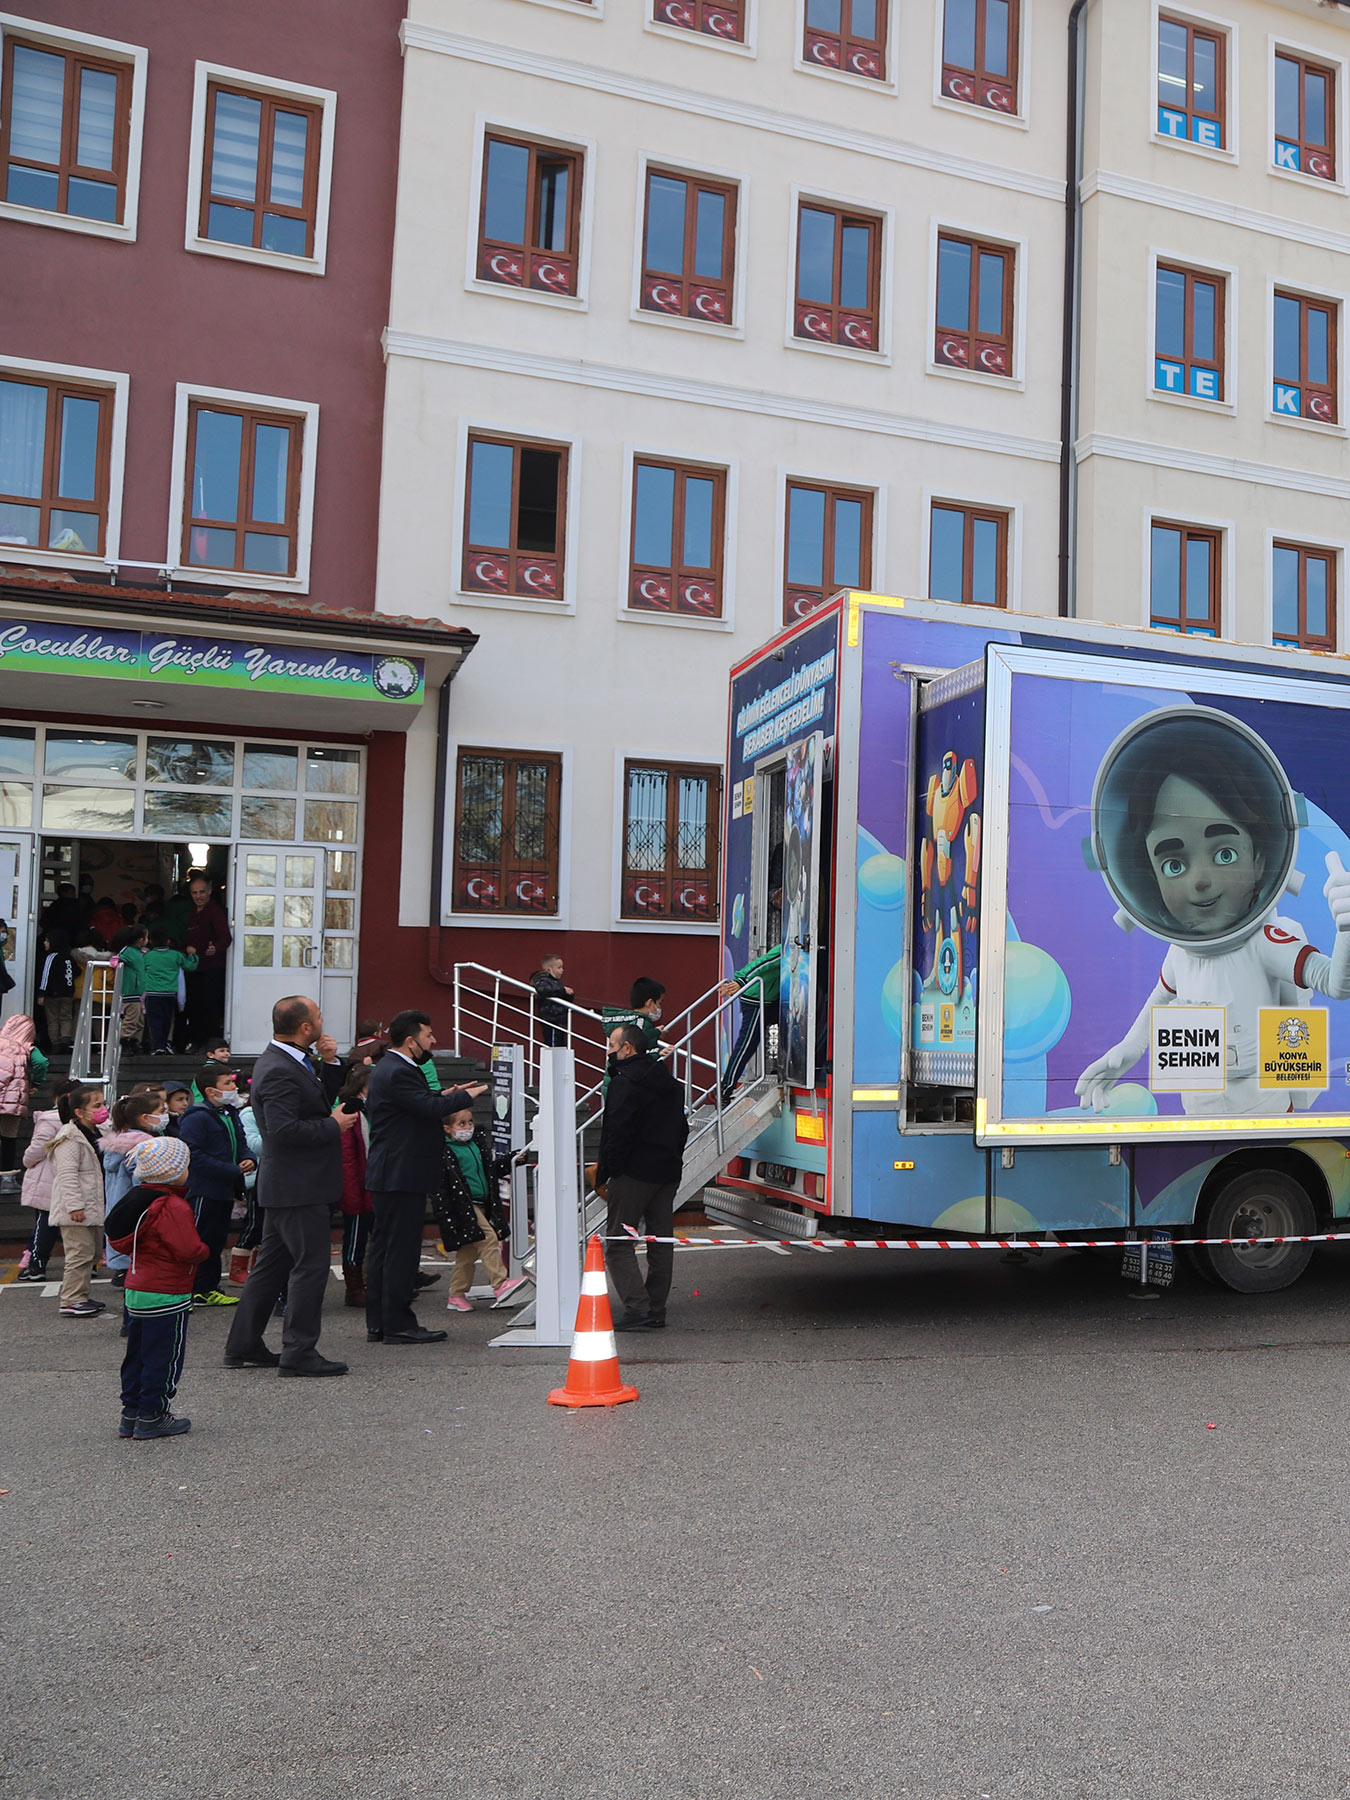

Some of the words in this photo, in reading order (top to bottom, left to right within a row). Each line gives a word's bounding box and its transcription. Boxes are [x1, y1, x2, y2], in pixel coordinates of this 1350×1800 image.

[148, 640, 233, 674] Güçlü
[1158, 1029, 1219, 1047] BENİM
[1158, 1052, 1219, 1070] ŞEHRİM
[1279, 1052, 1307, 1060] KONYA
[1264, 1061, 1322, 1073] BÜYÜKŞEHİR
